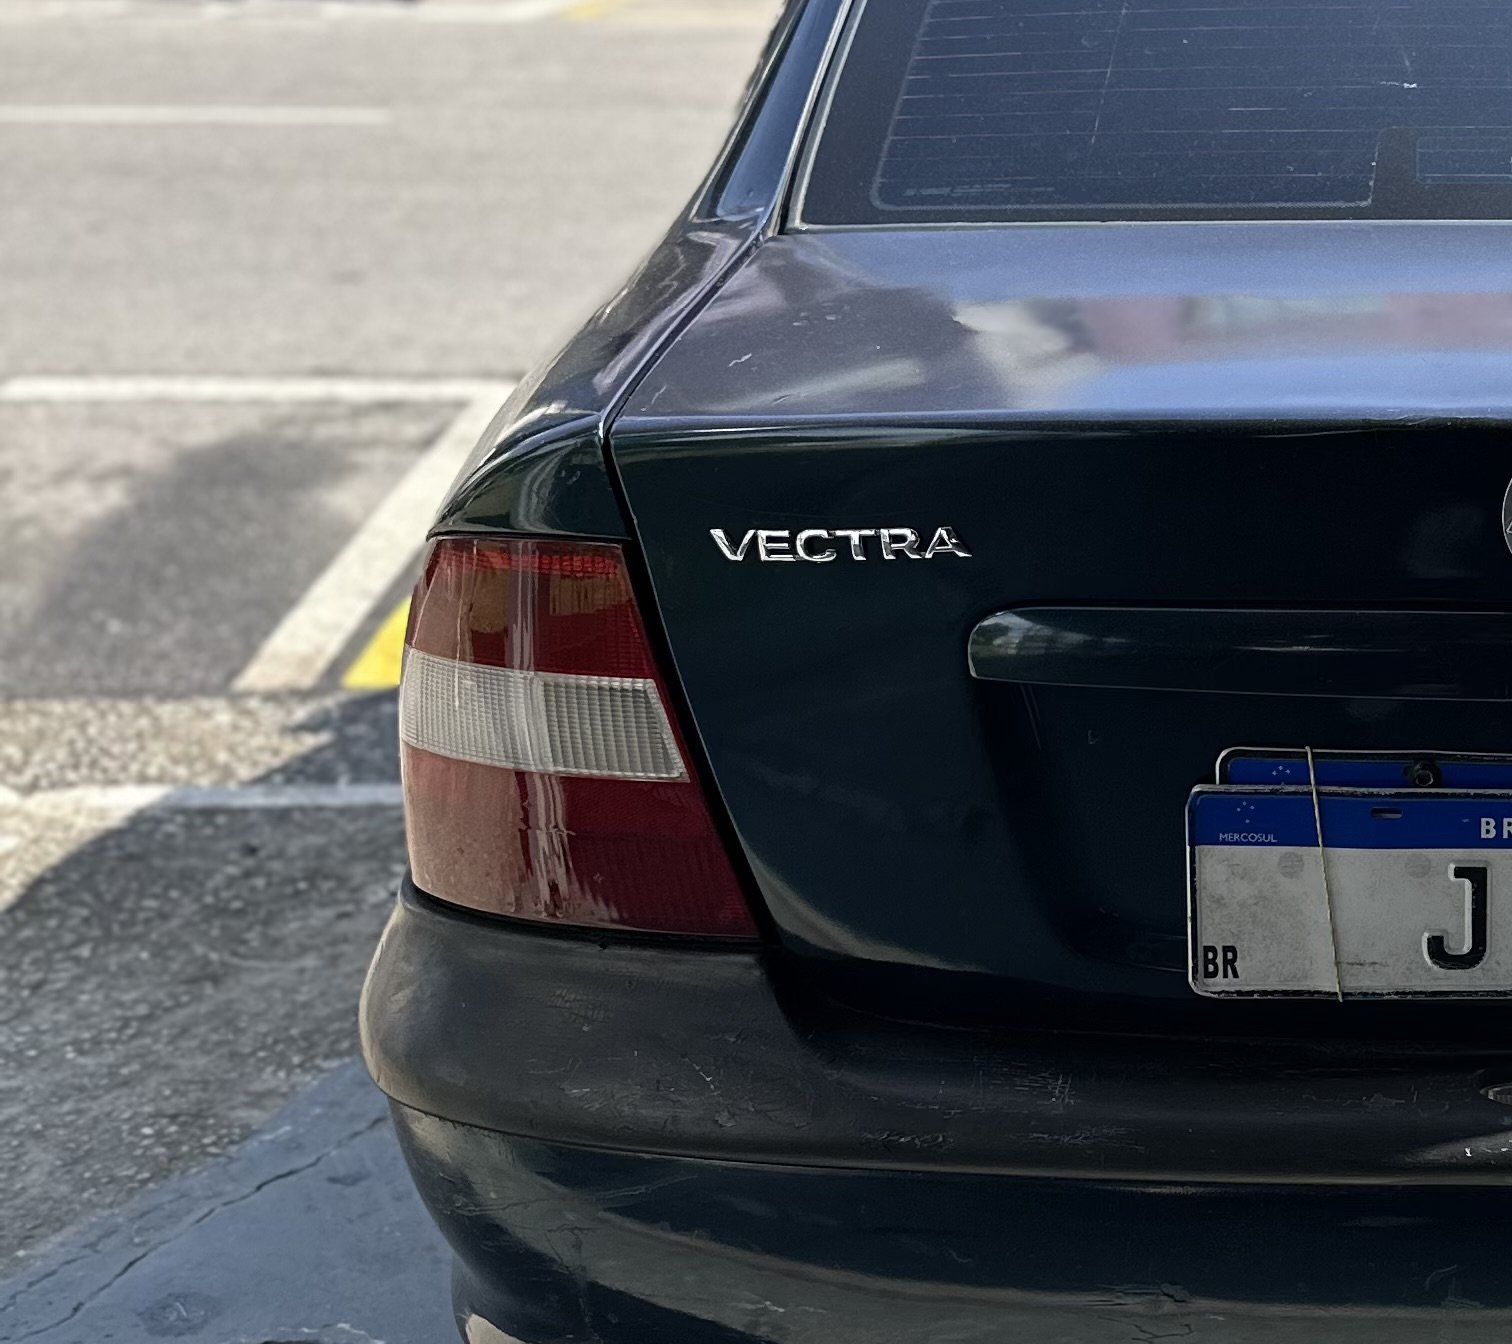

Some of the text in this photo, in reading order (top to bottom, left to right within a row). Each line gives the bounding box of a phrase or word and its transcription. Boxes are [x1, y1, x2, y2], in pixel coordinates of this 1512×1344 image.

[709, 526, 973, 563] VECTRA
[1218, 832, 1279, 844] MERCOSUL
[1420, 863, 1491, 971] J
[1201, 943, 1241, 980] BR
